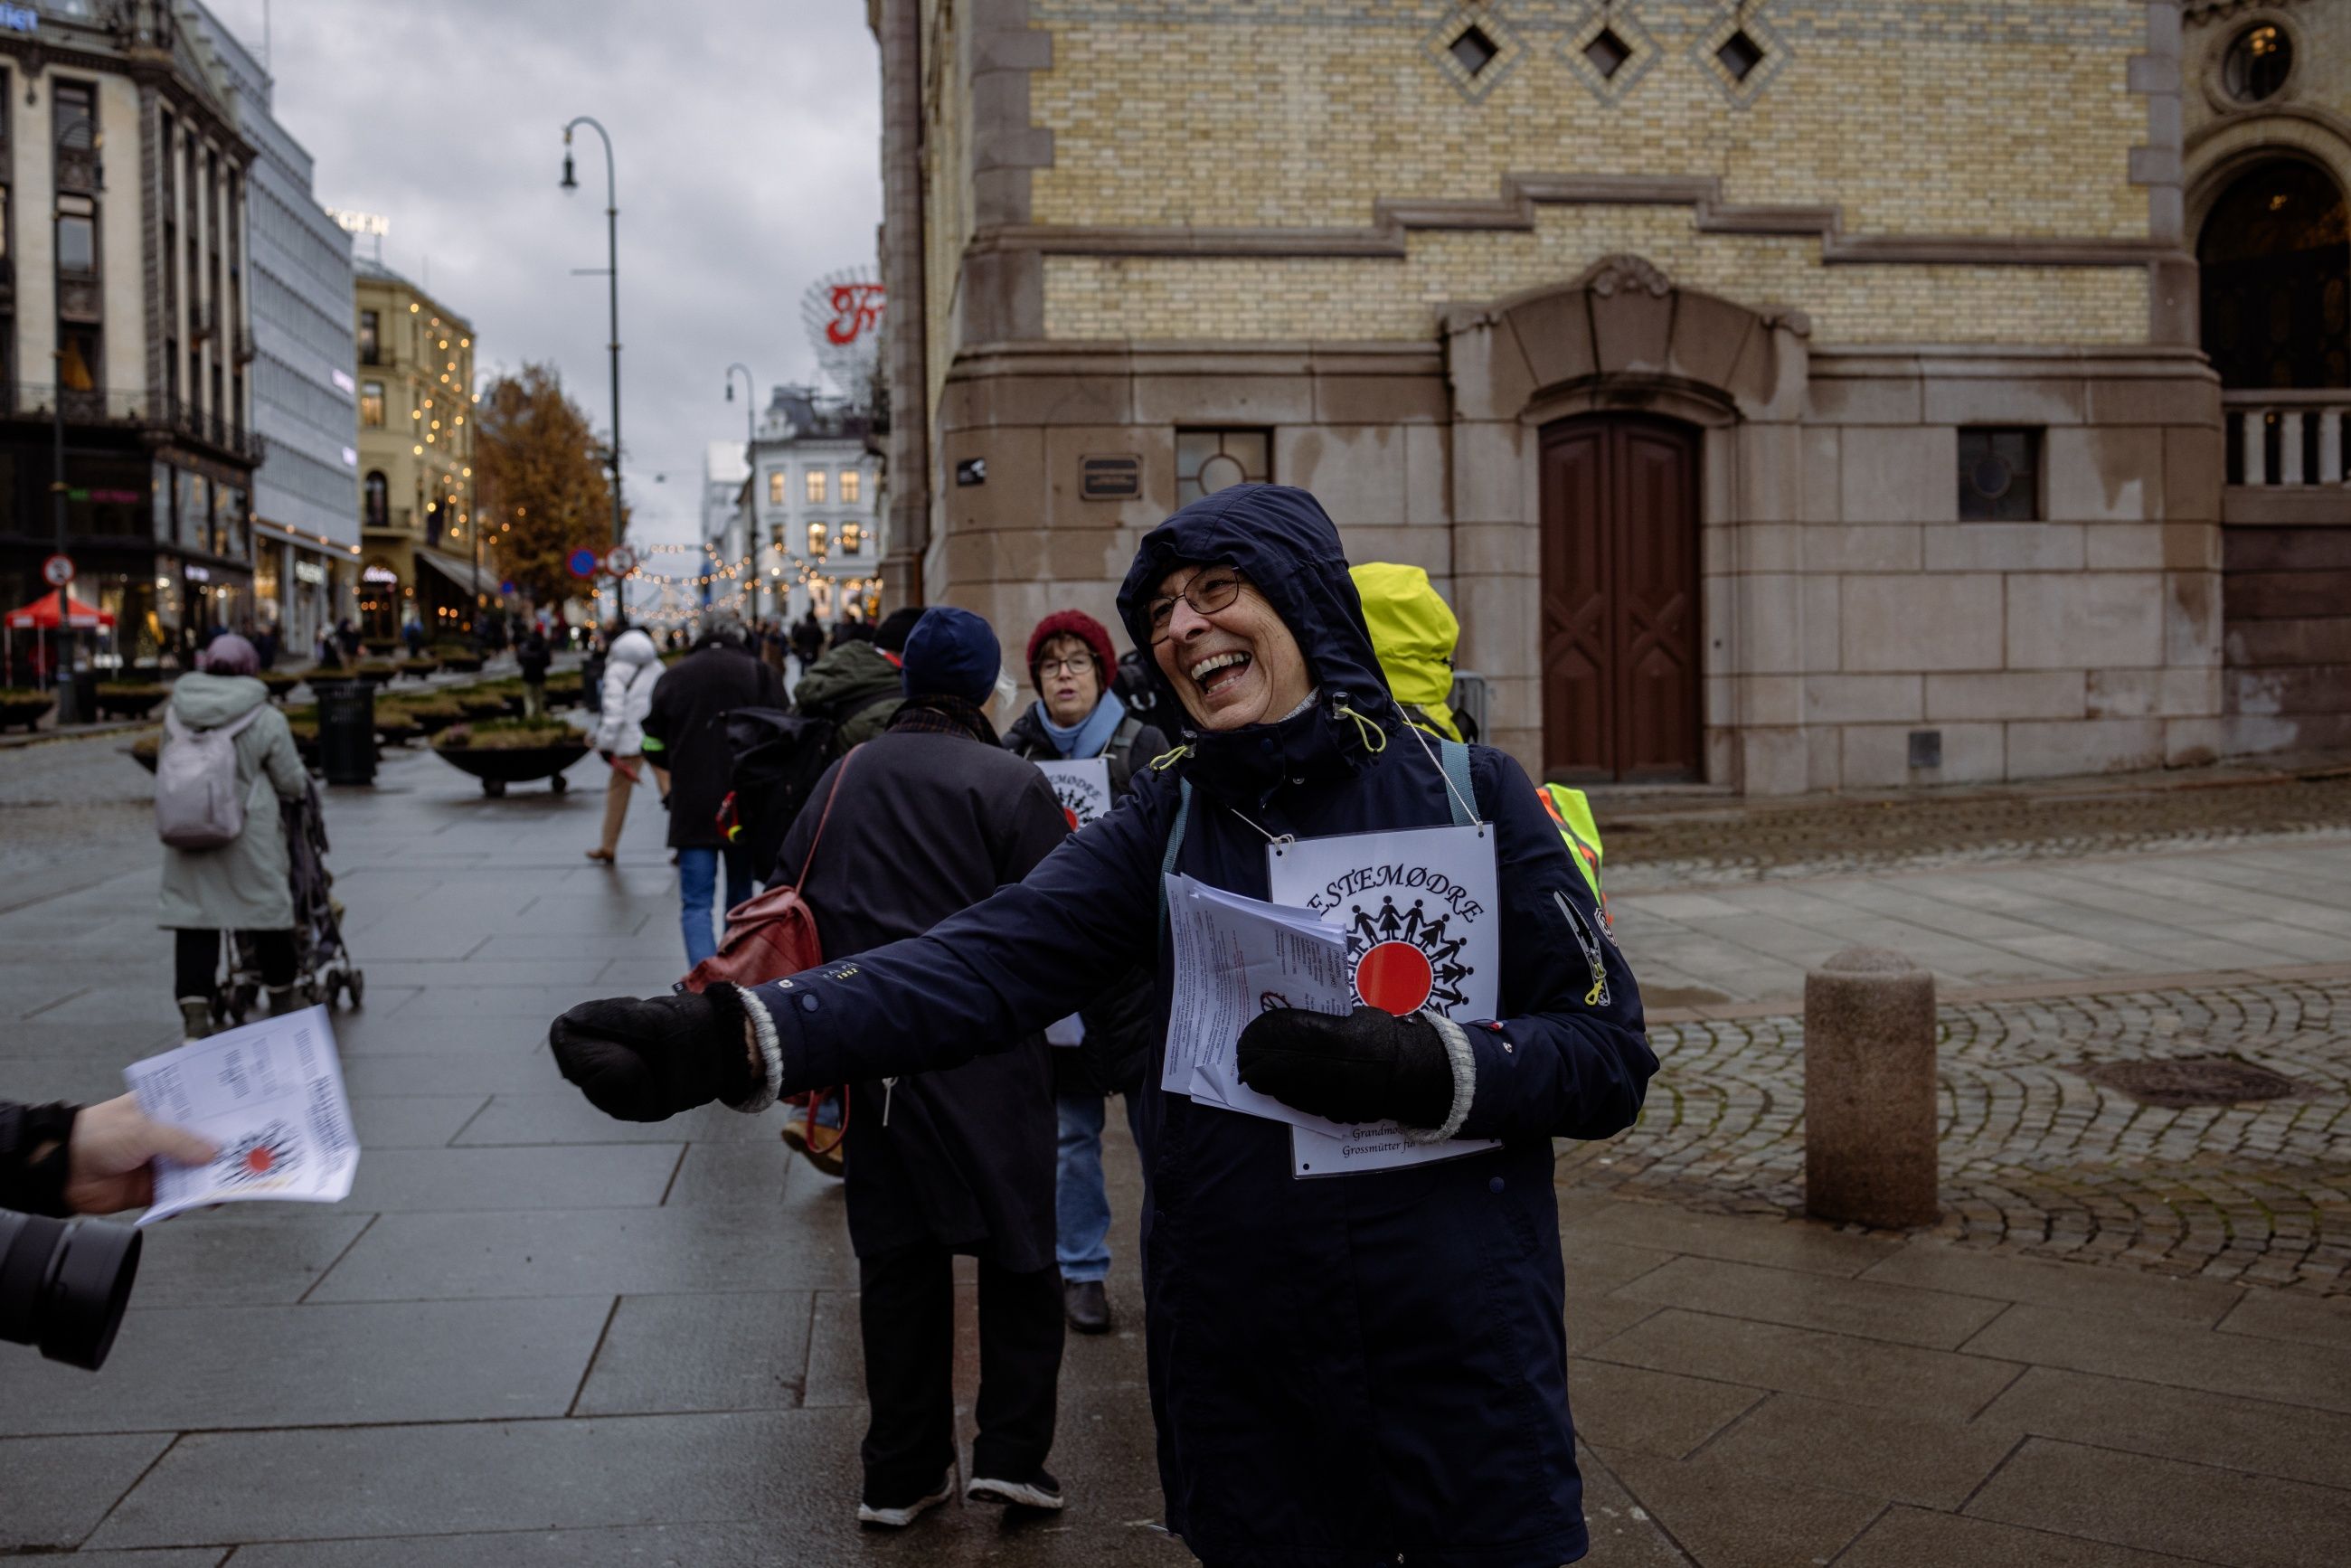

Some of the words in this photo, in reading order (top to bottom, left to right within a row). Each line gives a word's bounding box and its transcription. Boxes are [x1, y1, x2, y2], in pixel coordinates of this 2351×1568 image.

[1048, 774, 1102, 800] EMØDRE
[1307, 864, 1485, 923] ESTEMØDRE
[1352, 1123, 1401, 1141] Grandmo
[1342, 1142, 1401, 1158] Grossmütter
